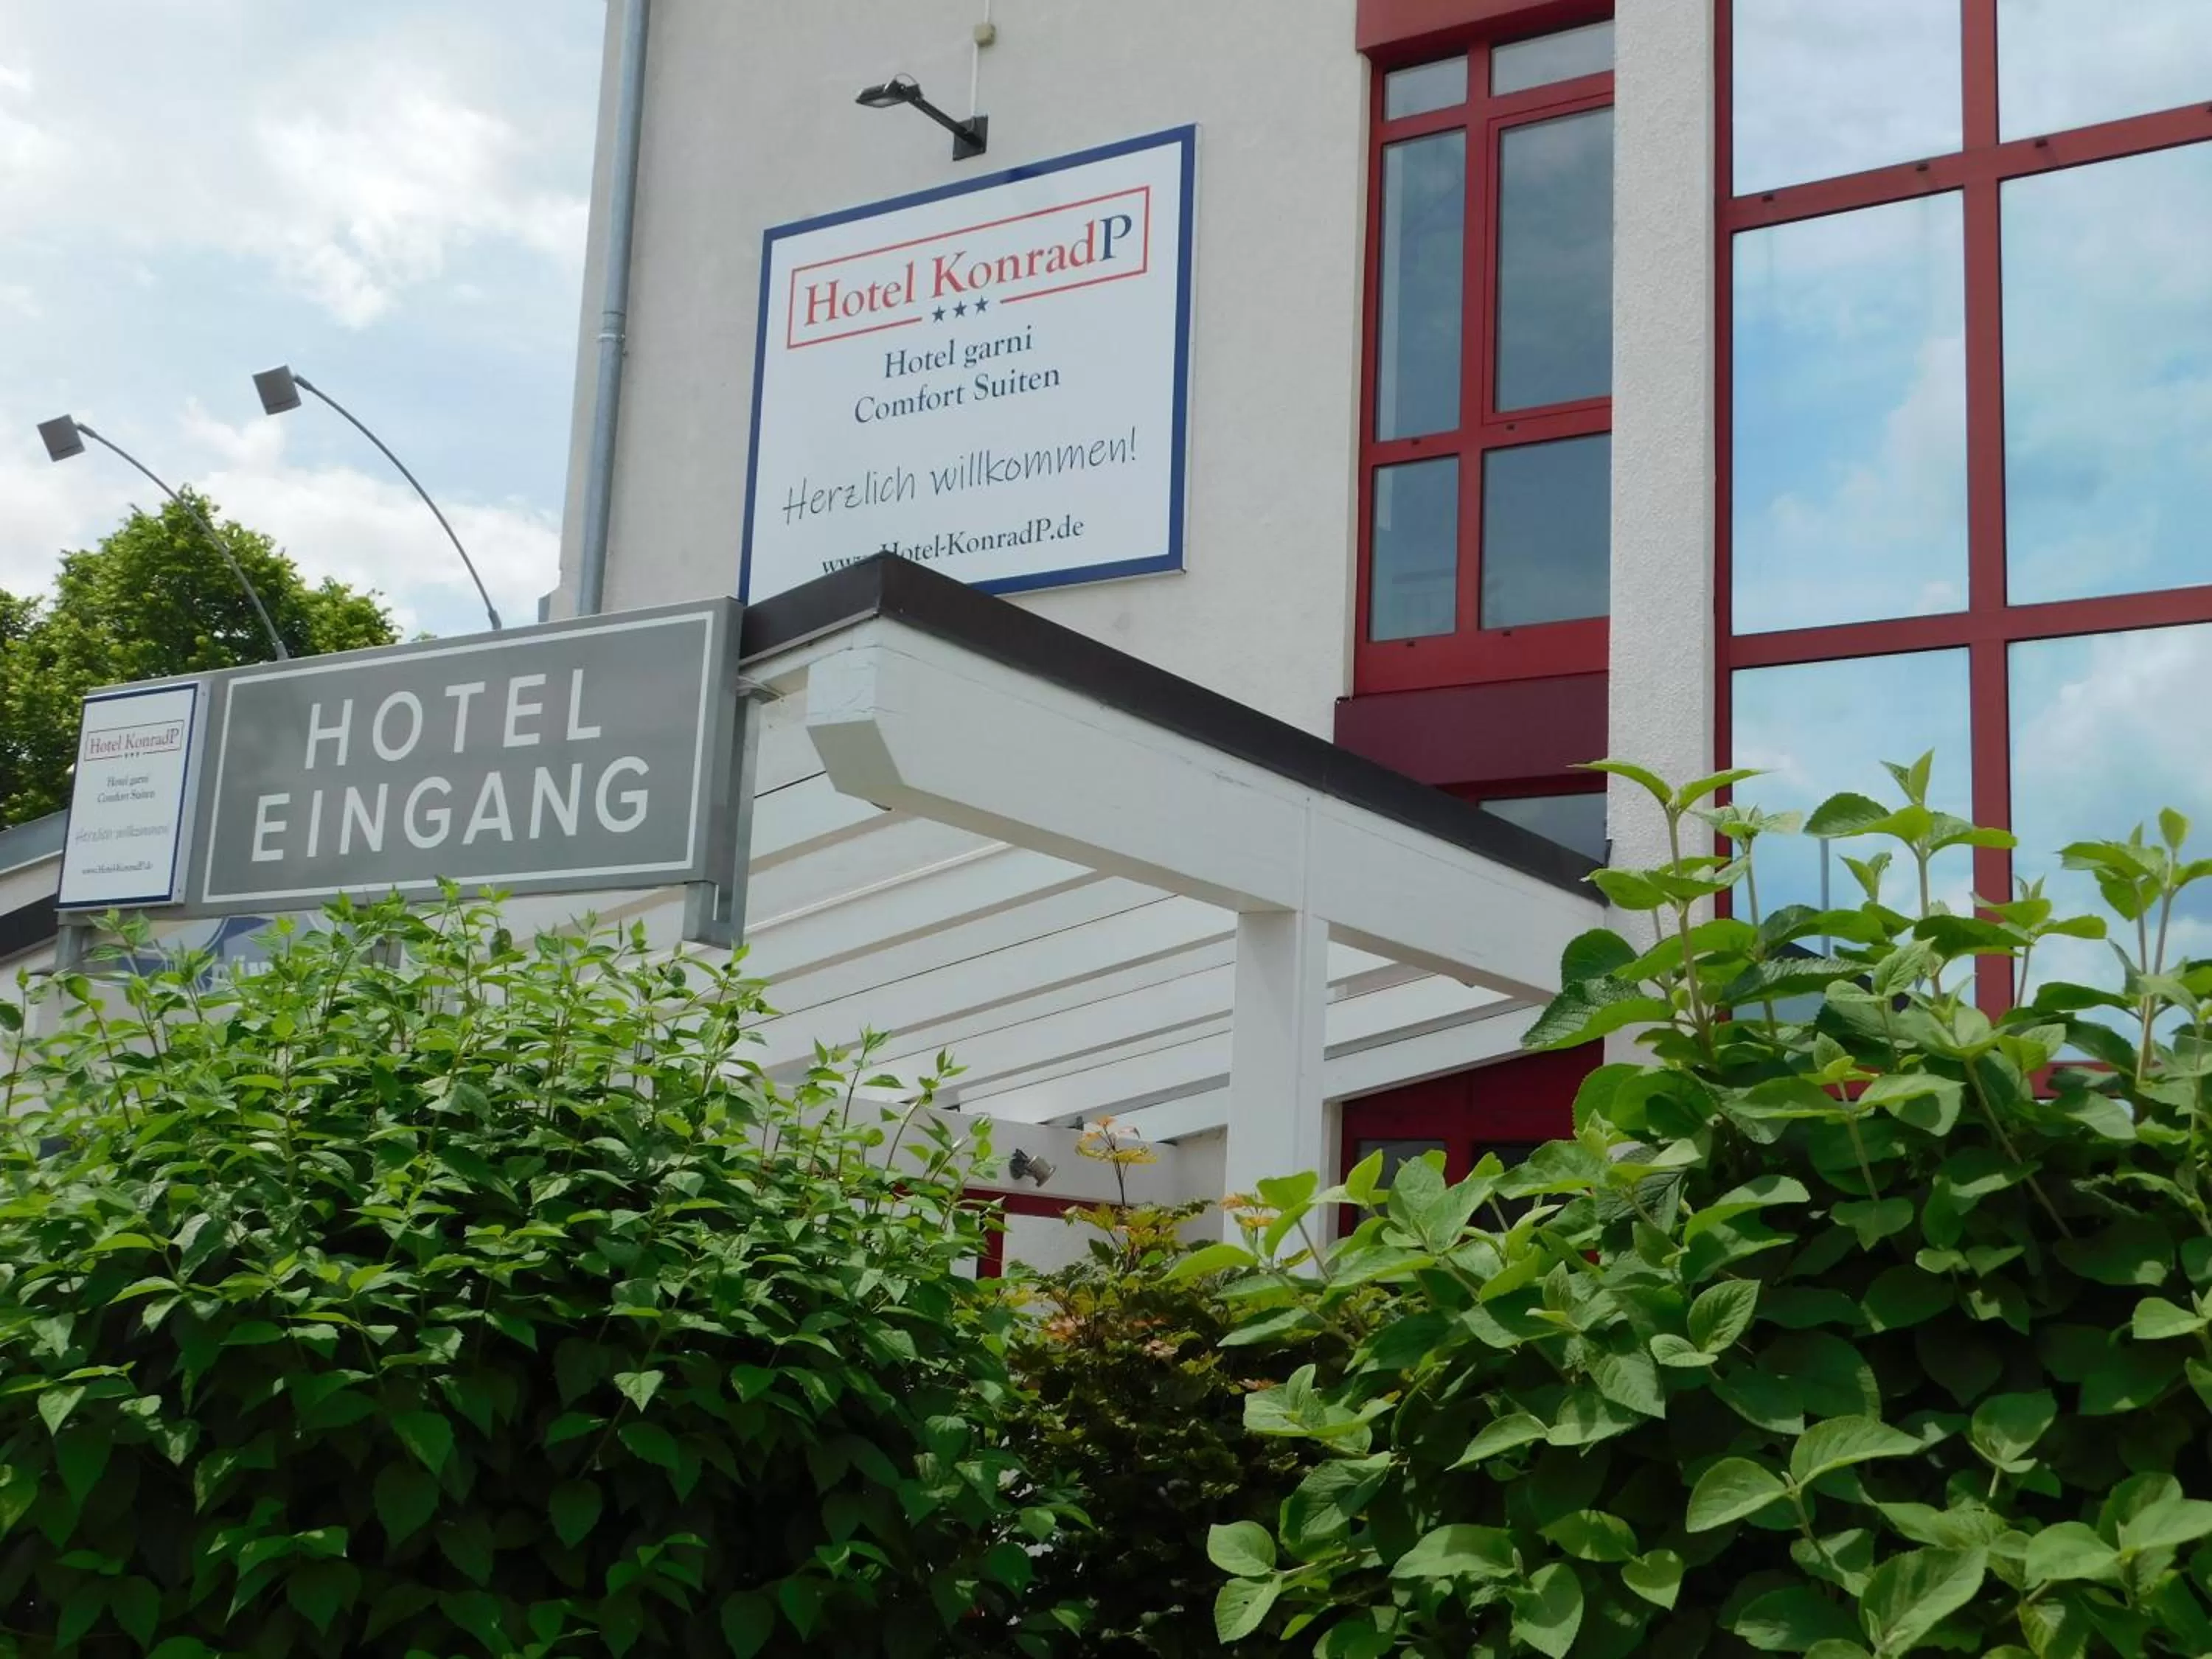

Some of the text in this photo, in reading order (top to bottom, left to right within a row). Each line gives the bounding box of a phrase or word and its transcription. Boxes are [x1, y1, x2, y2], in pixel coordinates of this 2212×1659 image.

[805, 213, 1133, 326] Hotel KonradP
[854, 369, 1060, 424] Comfort Suiten
[884, 324, 1034, 378] Hotel garni
[782, 427, 1137, 524] Herzlich willkommen!
[90, 728, 180, 754] Hotel KonradP
[305, 669, 602, 770] HOTEL
[251, 756, 649, 863] EINGANG
